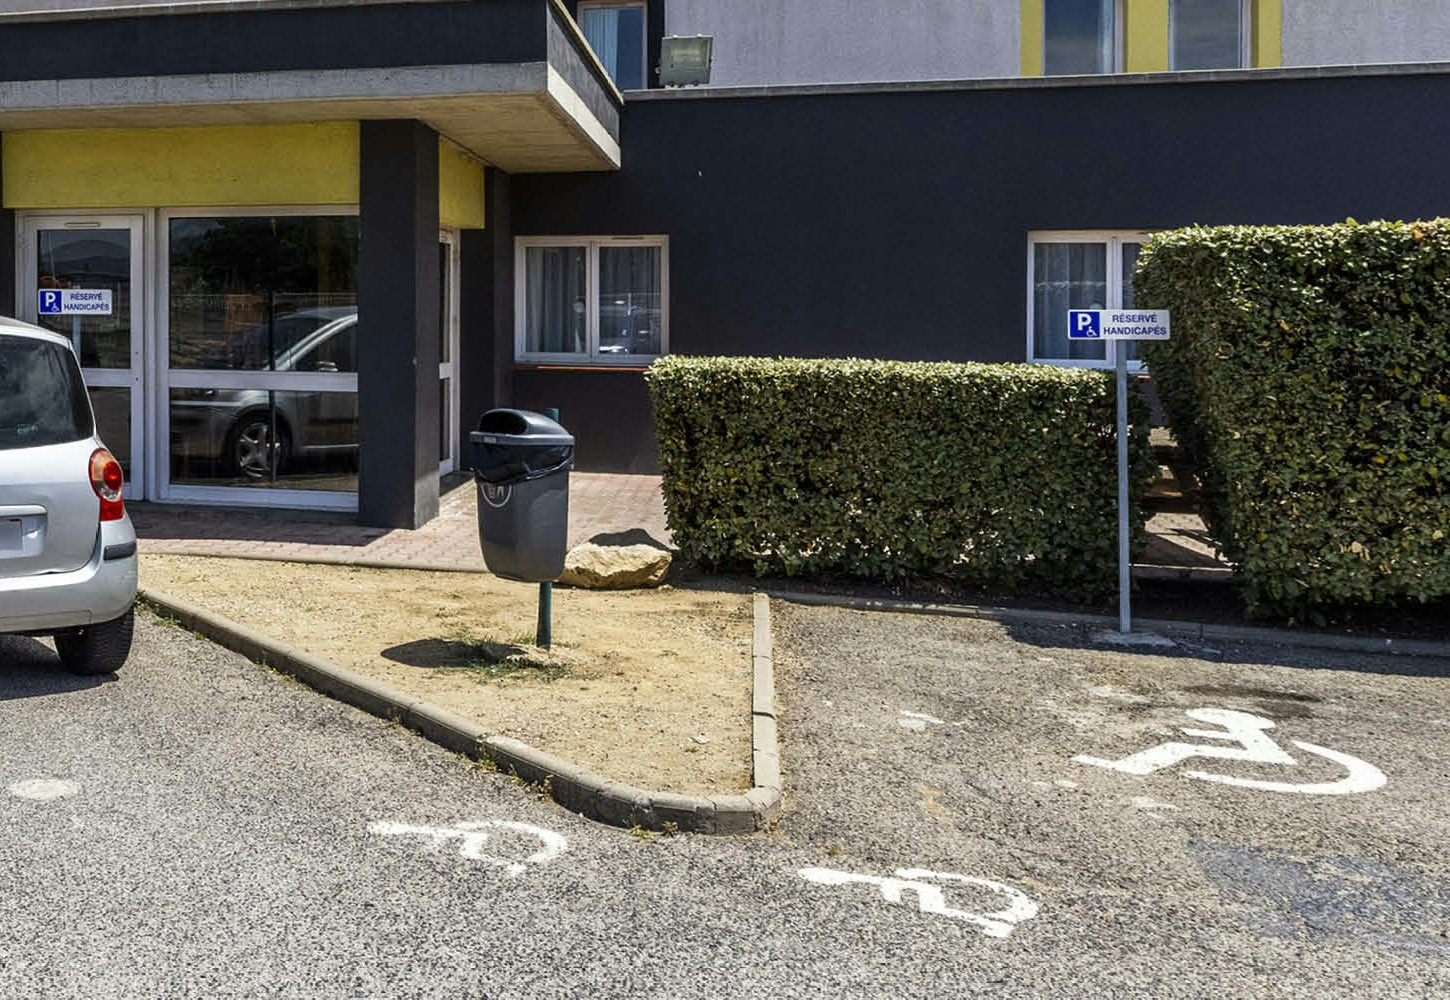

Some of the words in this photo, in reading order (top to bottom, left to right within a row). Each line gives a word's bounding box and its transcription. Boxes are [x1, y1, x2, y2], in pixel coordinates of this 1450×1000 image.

[63, 302, 110, 312] HANDICAPÉS
[1112, 313, 1158, 323] RÉSERVÉ
[1103, 325, 1167, 336] HANDICAPÉS
